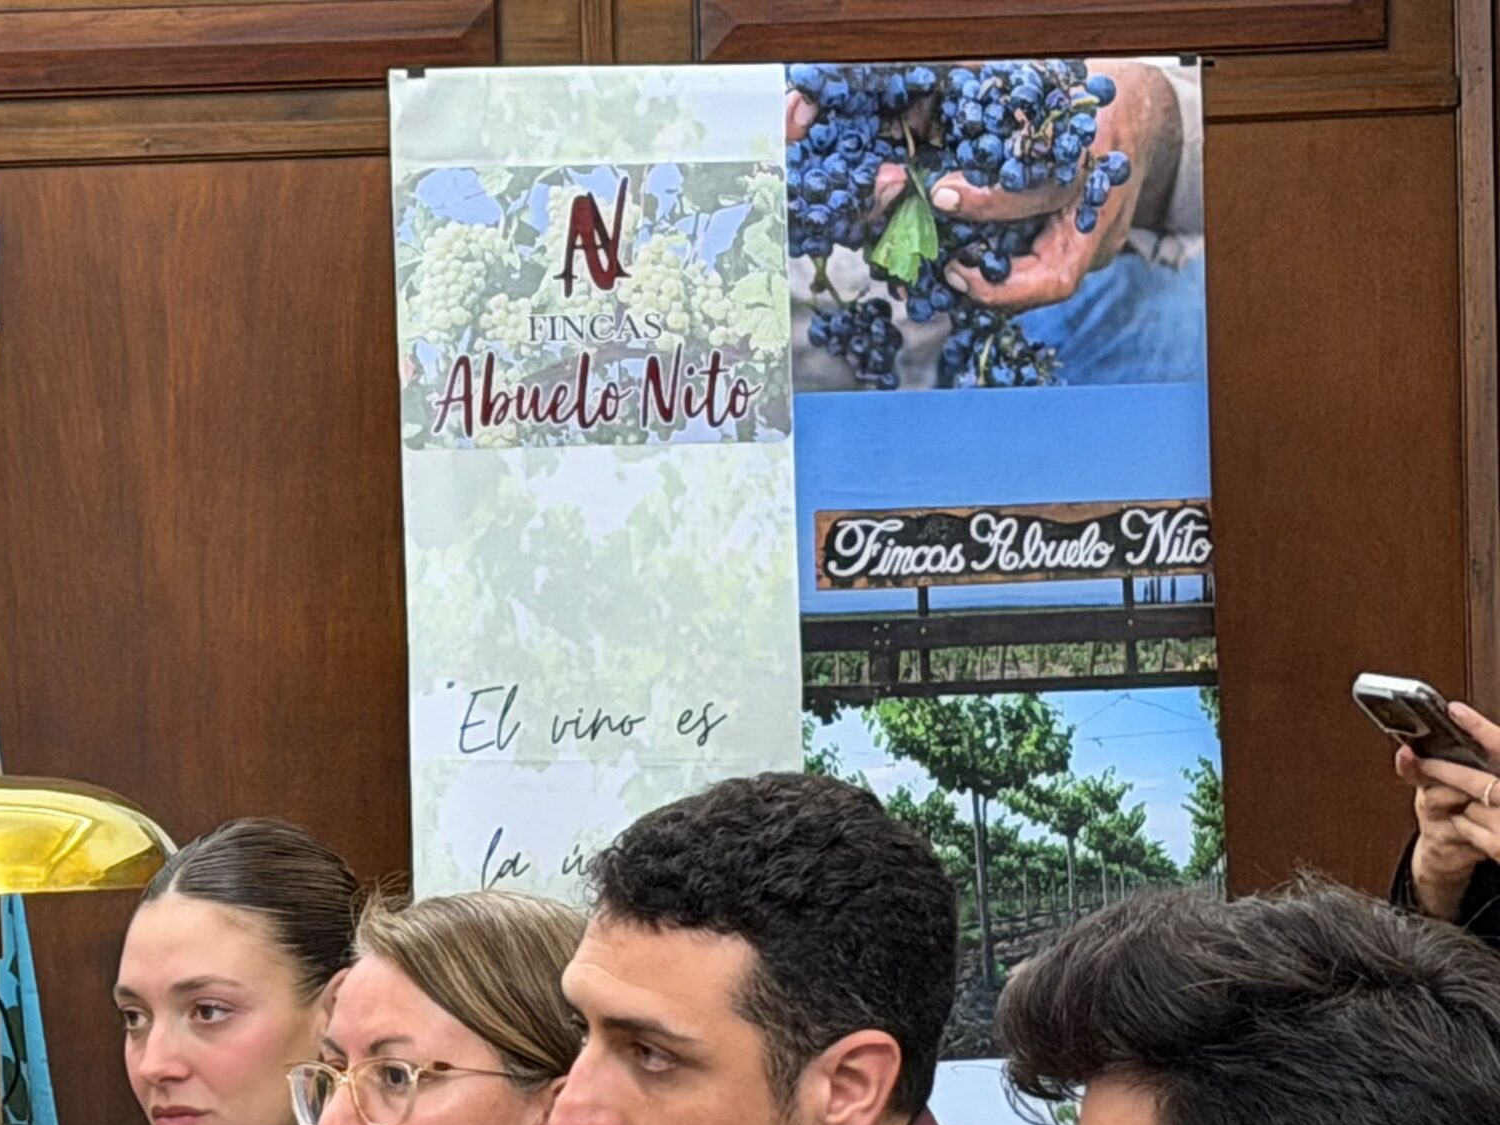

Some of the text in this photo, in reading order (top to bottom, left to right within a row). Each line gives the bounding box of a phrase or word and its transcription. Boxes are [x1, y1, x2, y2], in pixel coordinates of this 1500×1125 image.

[528, 313, 662, 341] FINCAS
[433, 342, 763, 437] Abuelo Nito
[827, 508, 1213, 577] Fincas Abuelo Nito
[551, 707, 647, 744] vino
[677, 702, 728, 747] es
[481, 827, 531, 891] la
